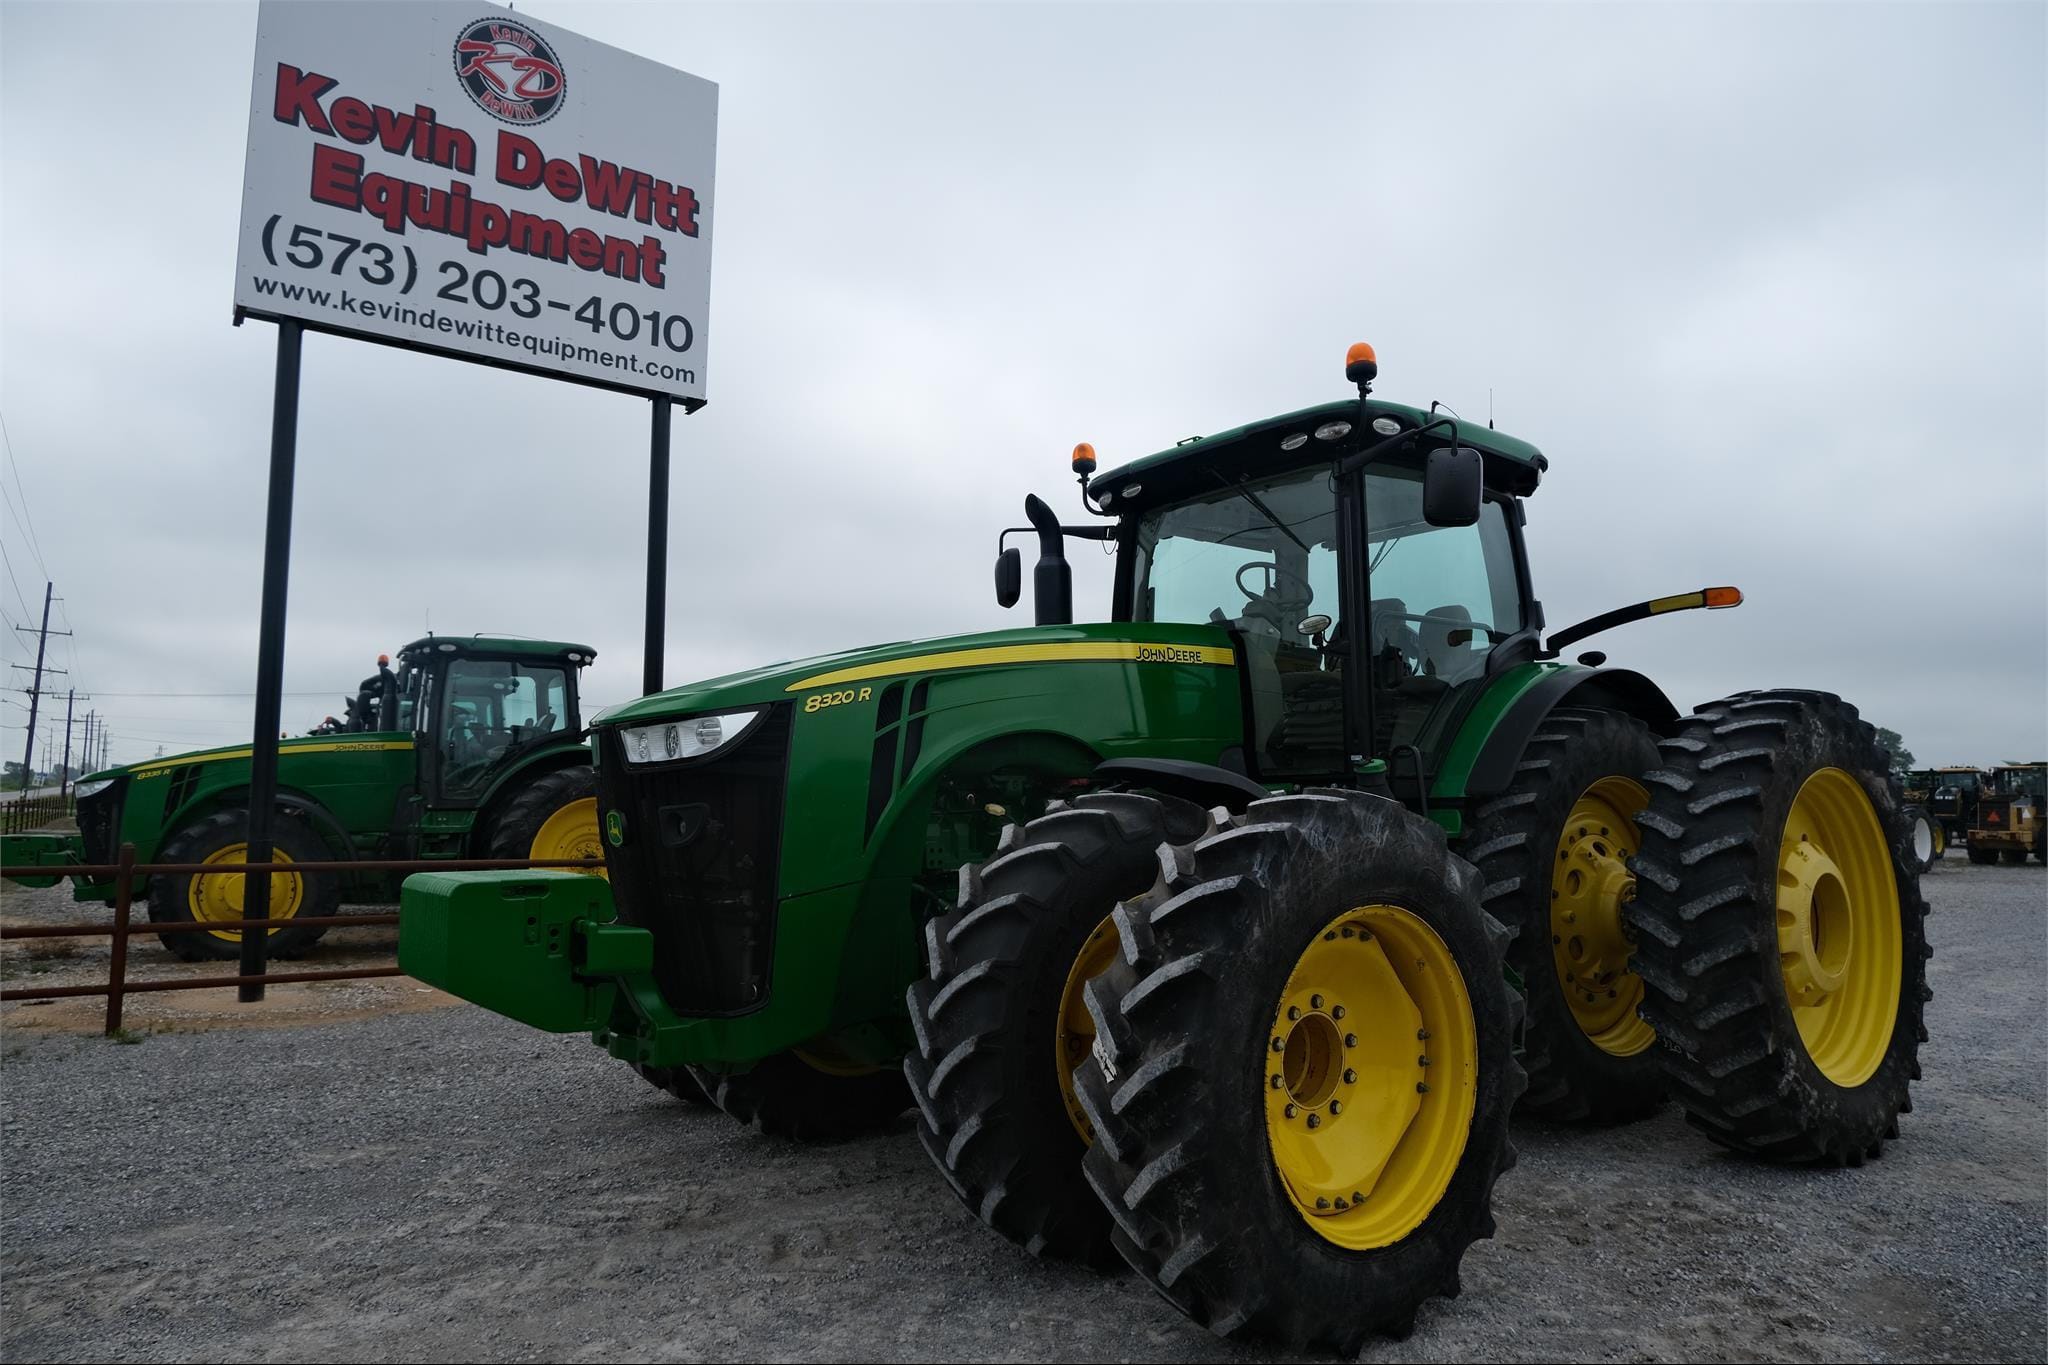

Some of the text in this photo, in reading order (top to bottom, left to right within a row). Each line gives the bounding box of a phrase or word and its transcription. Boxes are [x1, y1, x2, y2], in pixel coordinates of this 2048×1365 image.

[457, 39, 563, 99] KD
[489, 24, 537, 52] Kevin
[480, 90, 537, 119] DeWitt
[273, 62, 700, 238] Kevin DeWitt
[310, 142, 667, 289] Equipment
[262, 214, 694, 353] (573) 203-4010
[253, 276, 695, 384] www.kevindewittequipment.com
[804, 687, 872, 713] 8320 R
